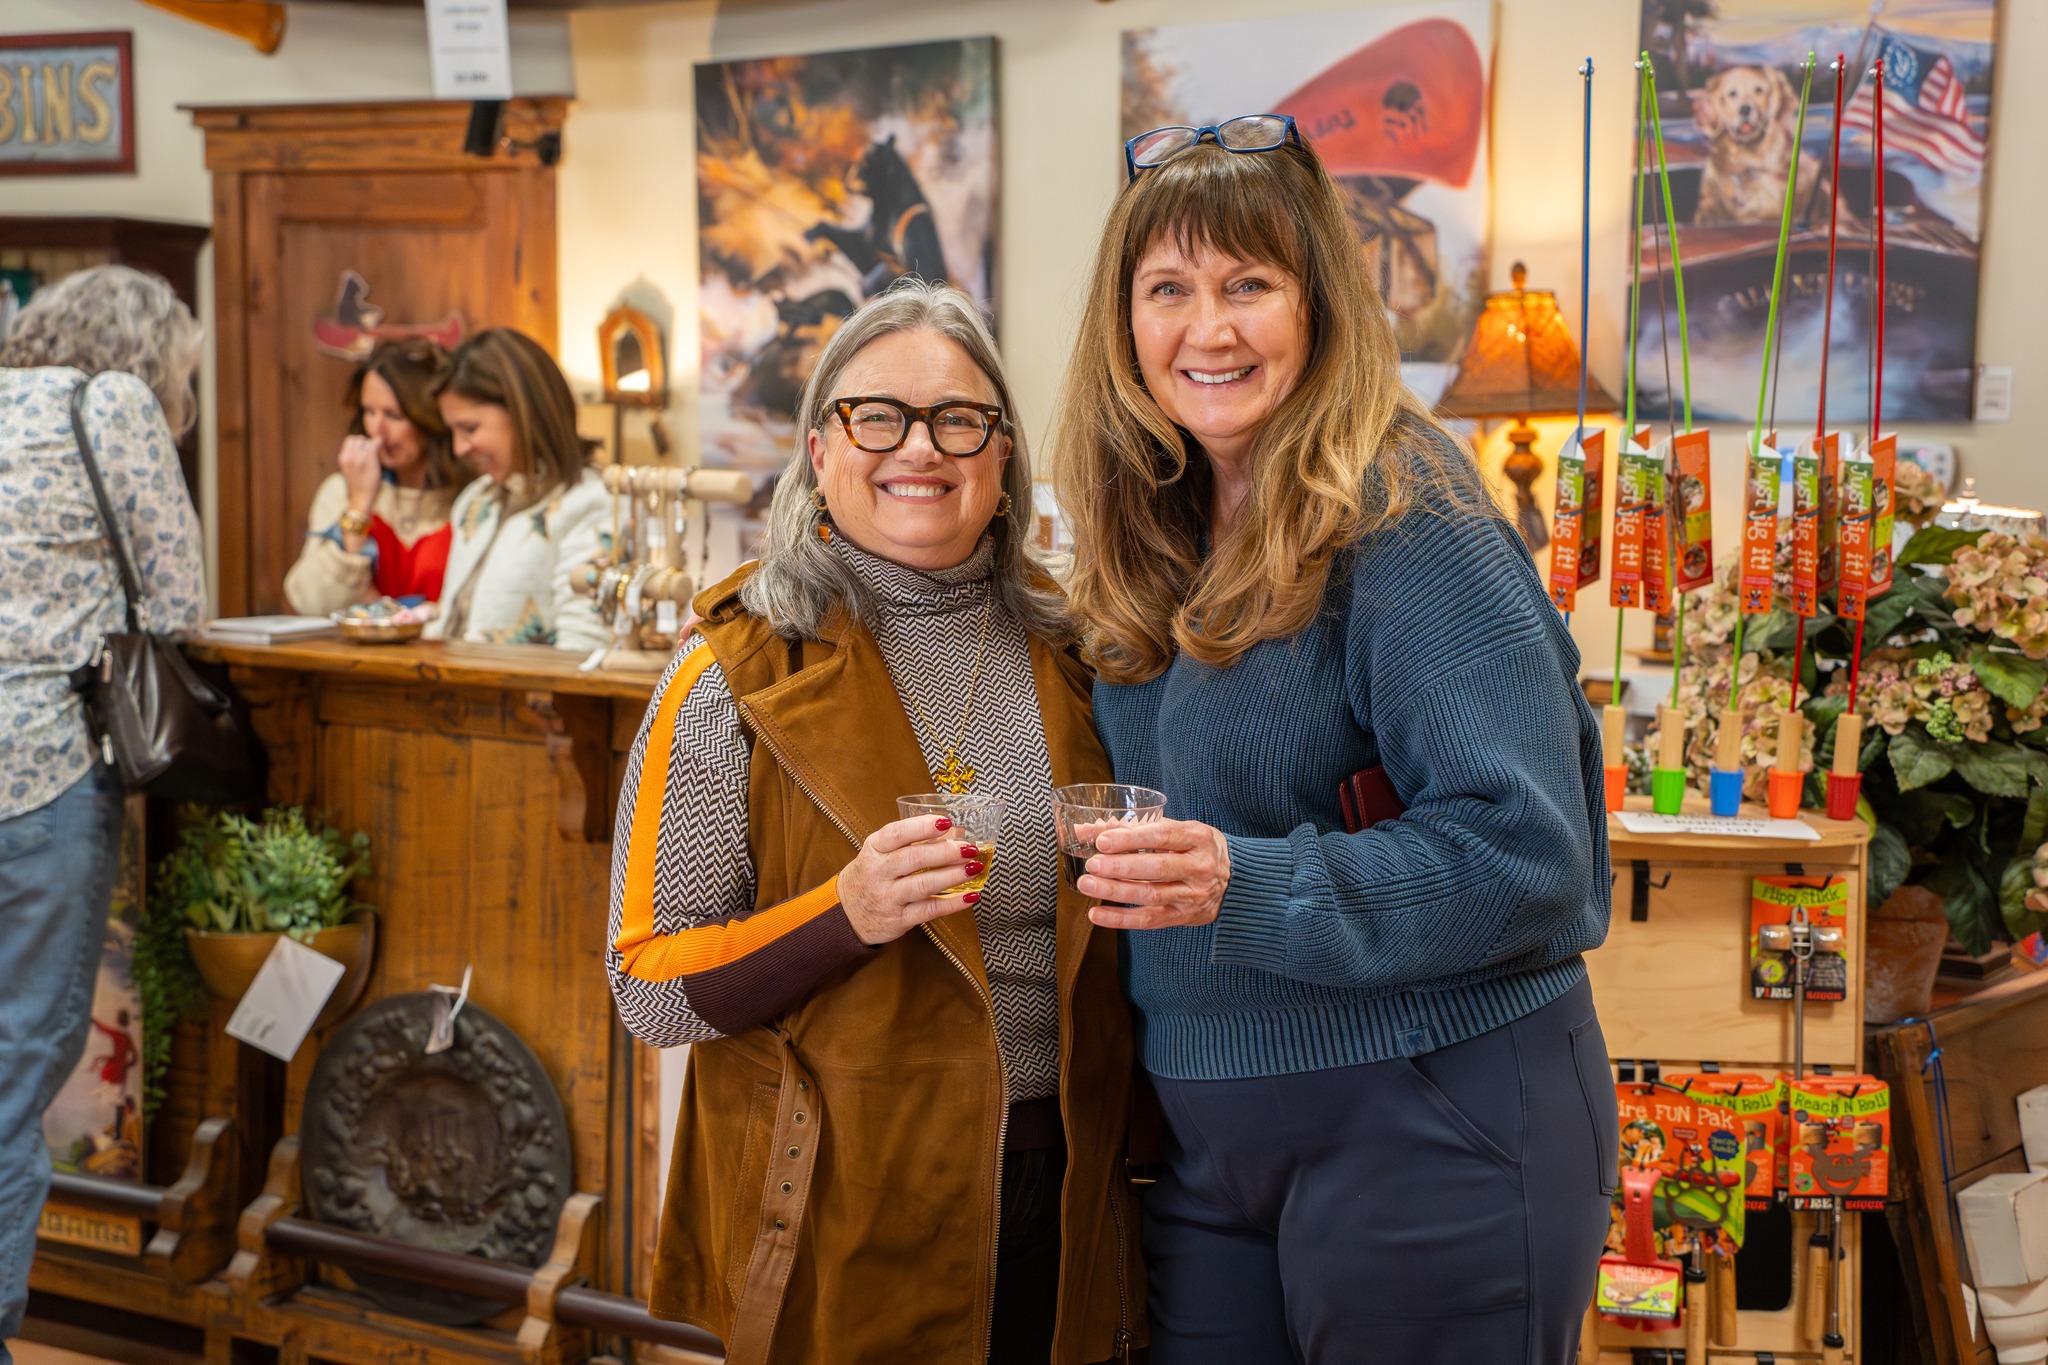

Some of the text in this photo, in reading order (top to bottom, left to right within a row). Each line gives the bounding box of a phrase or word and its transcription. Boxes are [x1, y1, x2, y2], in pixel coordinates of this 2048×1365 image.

[1559, 458, 1579, 510] Just
[1621, 456, 1643, 508] Just
[1756, 459, 1777, 510] Just
[1797, 460, 1815, 510] Just
[1847, 464, 1868, 515] Just
[1553, 507, 1577, 539] jig
[1614, 507, 1640, 538] jig
[1746, 509, 1774, 541] jig
[1793, 510, 1813, 542] jig
[1841, 513, 1866, 545] jig
[1555, 545, 1576, 570] it!
[1618, 542, 1640, 567] it!
[1750, 546, 1772, 571] it!
[1796, 547, 1813, 573] it!
[1844, 551, 1865, 577] it!
[1755, 986, 1793, 999] FIRE
[1617, 1099, 1735, 1130] ire FUN Pak
[1741, 1093, 1772, 1112] Roll
[1794, 1090, 1887, 1115] Reach N Roll
[1794, 1197, 1833, 1210] FIRE
